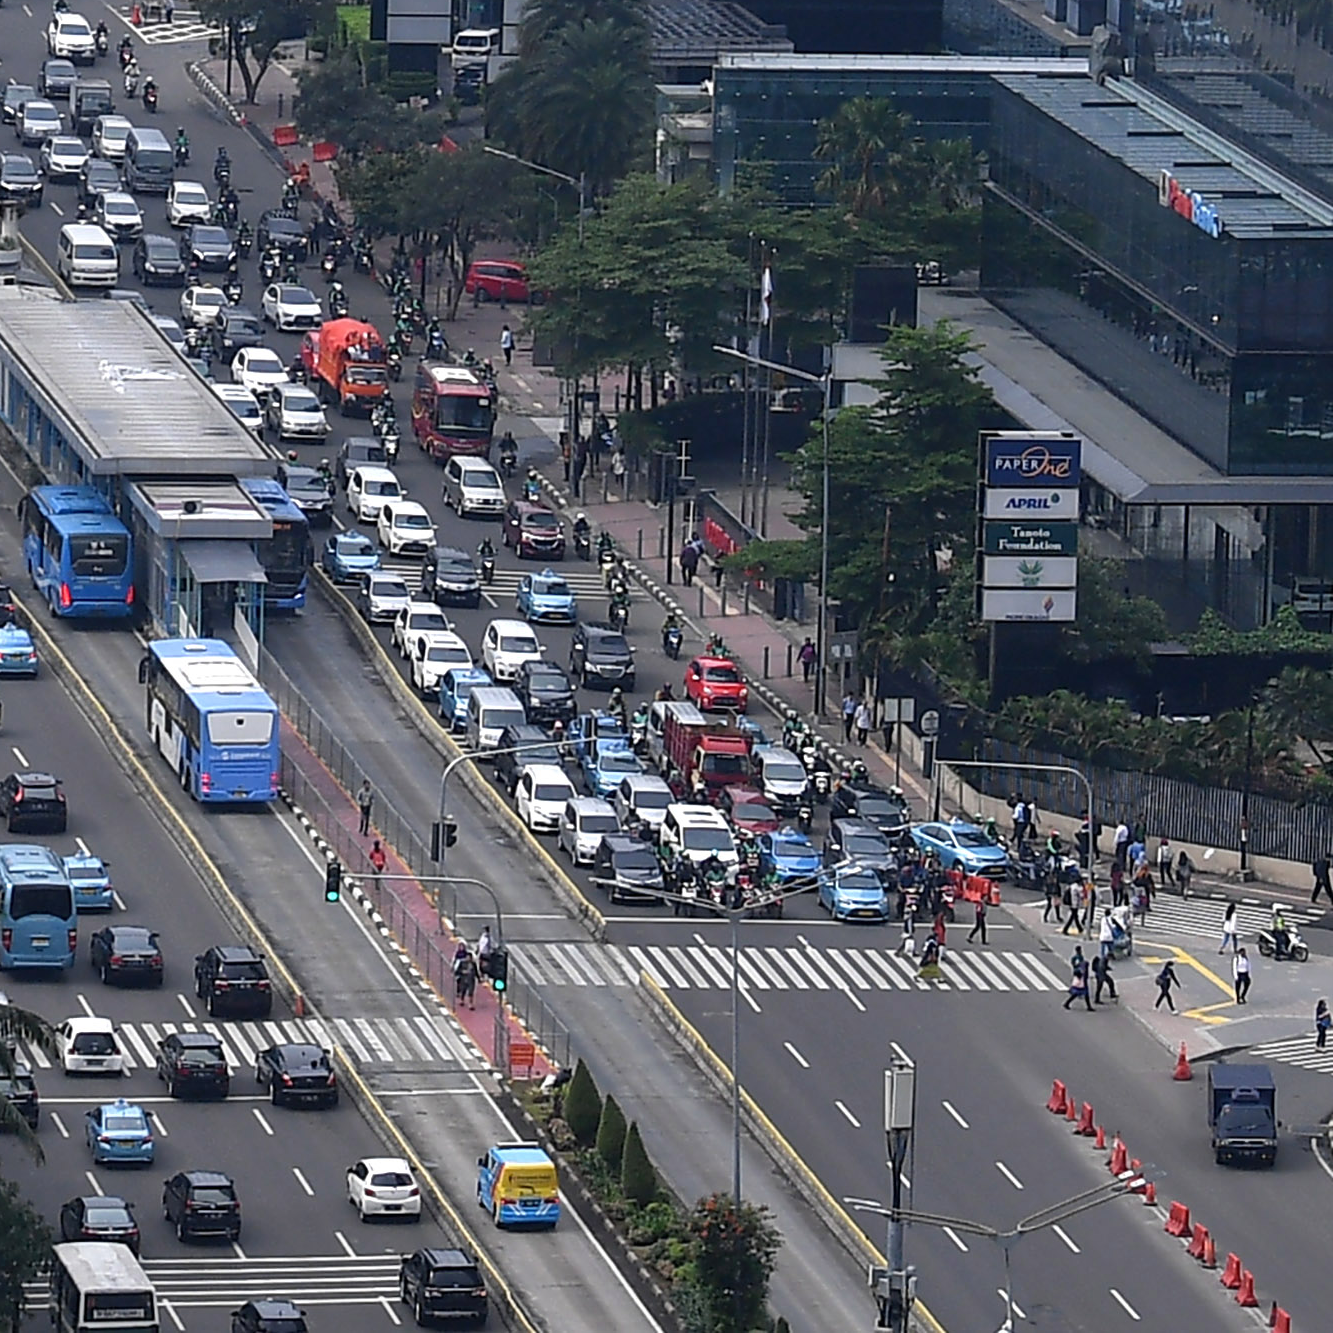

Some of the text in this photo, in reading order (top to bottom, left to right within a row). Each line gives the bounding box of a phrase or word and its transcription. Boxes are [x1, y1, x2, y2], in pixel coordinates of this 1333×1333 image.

[1005, 497, 1051, 509] APRIL
[1010, 526, 1051, 537] Tanoto
[998, 538, 1062, 550] Foundation
